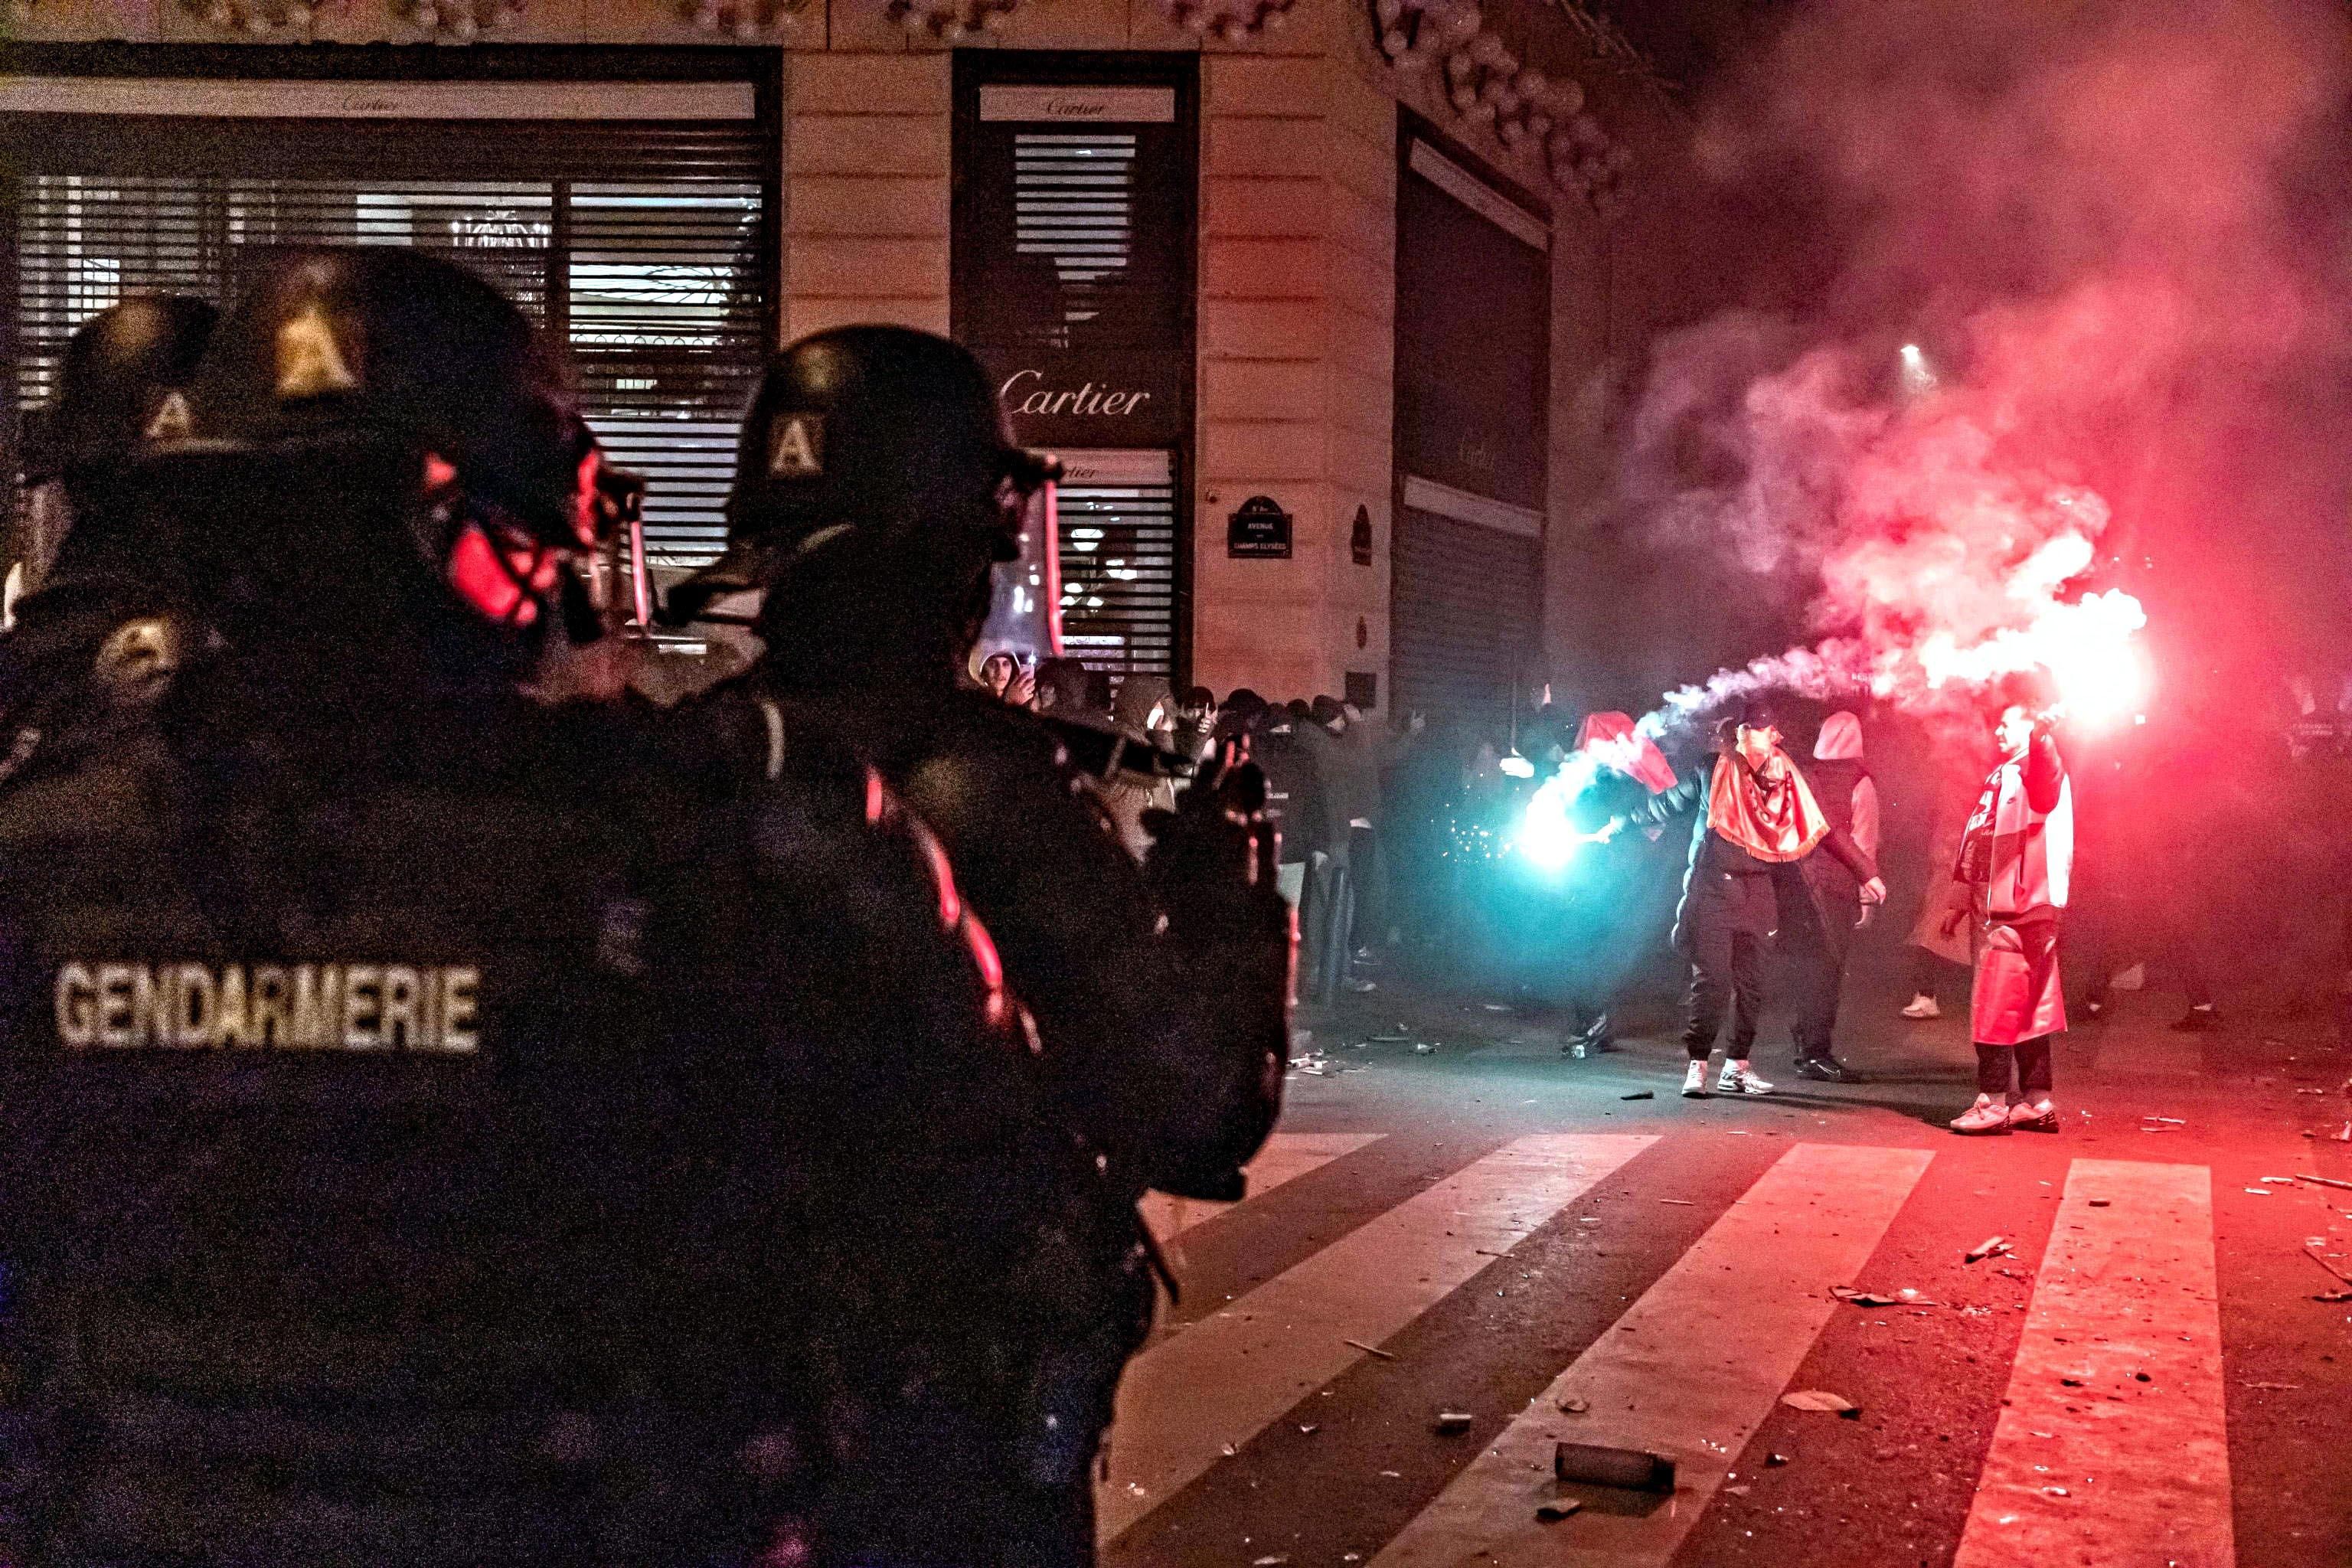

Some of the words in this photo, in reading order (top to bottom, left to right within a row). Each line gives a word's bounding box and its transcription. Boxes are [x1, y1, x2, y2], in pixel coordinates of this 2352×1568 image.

[1046, 97, 1105, 115] Cartier
[145, 390, 189, 437] A
[1001, 370, 1150, 415] Cartier
[773, 419, 819, 470] A
[56, 962, 480, 1051] GENDARMERIE
